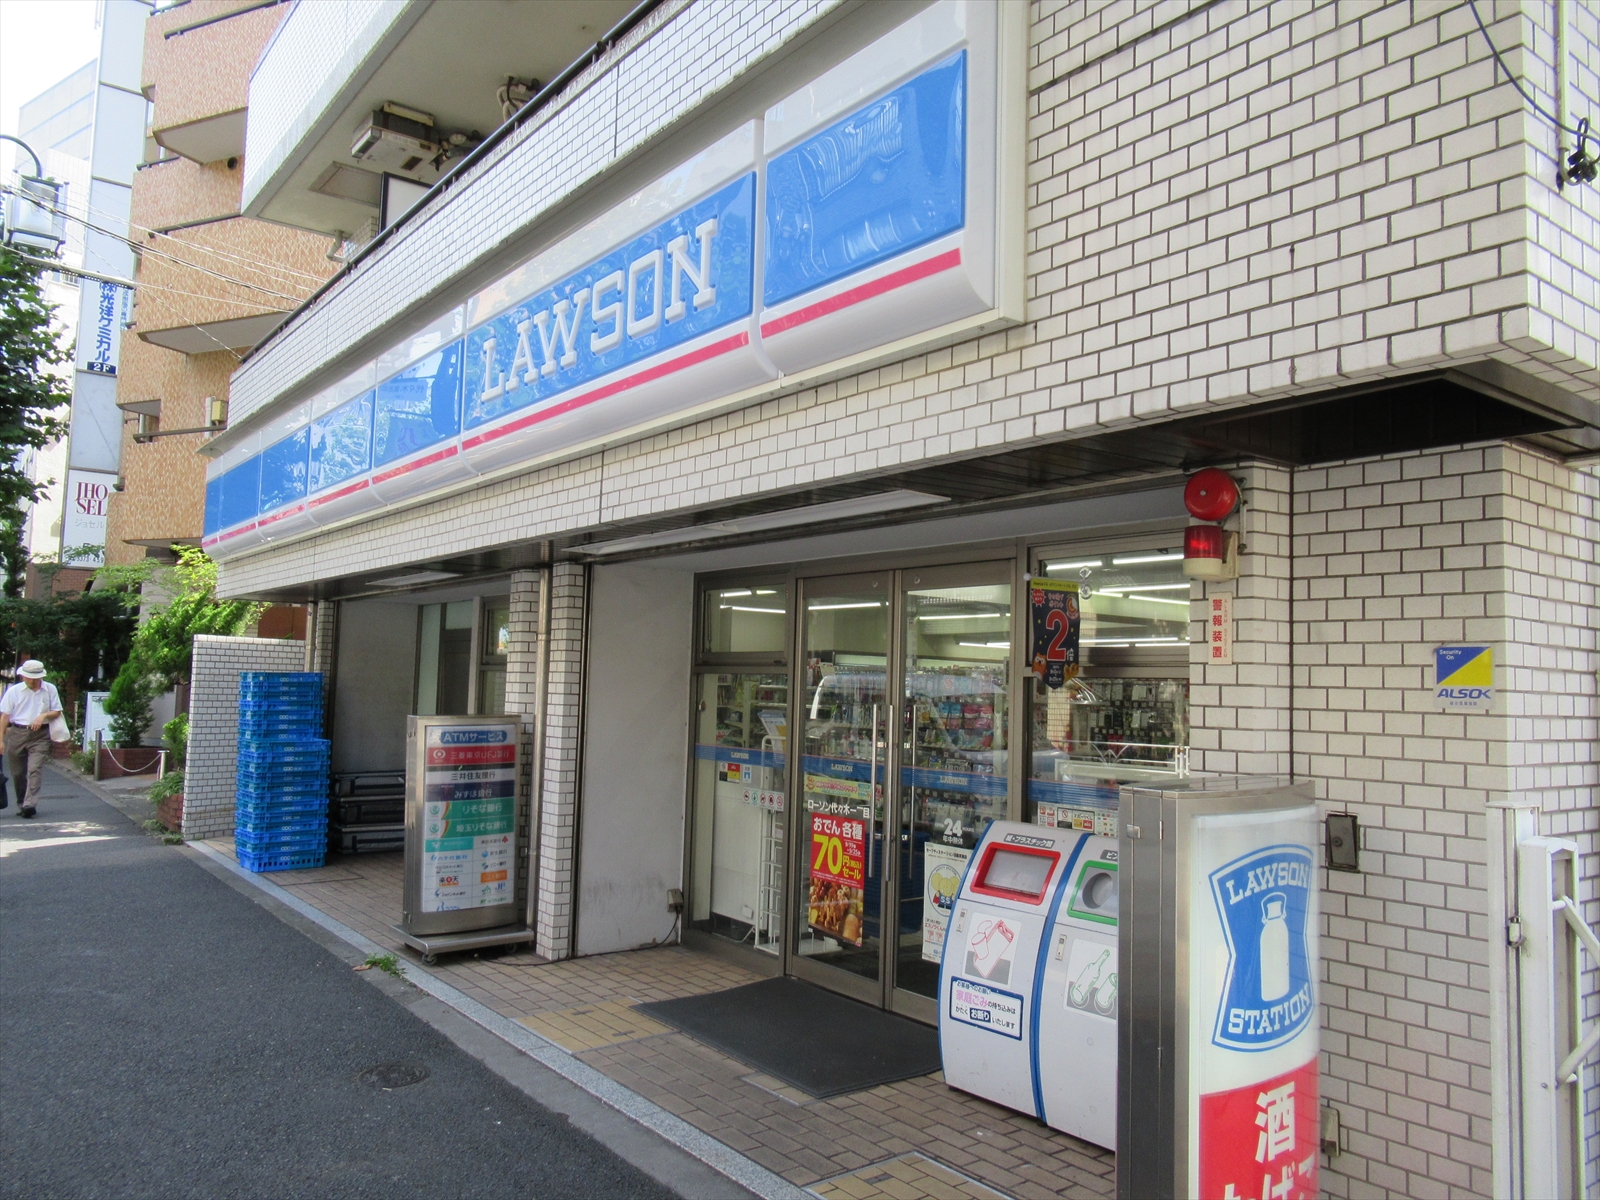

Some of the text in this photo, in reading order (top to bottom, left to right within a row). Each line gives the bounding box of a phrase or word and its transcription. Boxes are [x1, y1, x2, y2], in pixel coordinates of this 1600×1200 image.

[481, 217, 718, 404] LAWSON
[93, 363, 111, 372] 2F
[74, 482, 109, 501] JHO
[76, 499, 107, 516] SEL
[75, 519, 105, 529] ジョセル
[1046, 609, 1069, 661] 2
[1212, 598, 1223, 658] 警報装置
[1436, 688, 1492, 700] ALSOK
[443, 731, 504, 742] ATMサービス
[451, 750, 510, 760] 三菱東京UFJ銀行
[451, 771, 496, 780] 三井住友銀行
[831, 764, 853, 772] LAWSON
[454, 788, 493, 799] みずほ銀行
[462, 803, 503, 814] りそな銀行
[456, 821, 507, 832] 埼玉りそな銀行
[813, 817, 863, 840] おでん 各種
[943, 818, 963, 837] 24
[943, 835, 963, 845] 年中無休
[813, 834, 843, 875] 70
[843, 867, 861, 880] セール
[1226, 862, 1309, 905] LAWSON
[1228, 982, 1310, 1035] STATION
[970, 1009, 990, 1021] お断り
[991, 1017, 1015, 1029] いたします
[1255, 1081, 1296, 1164] 酒
